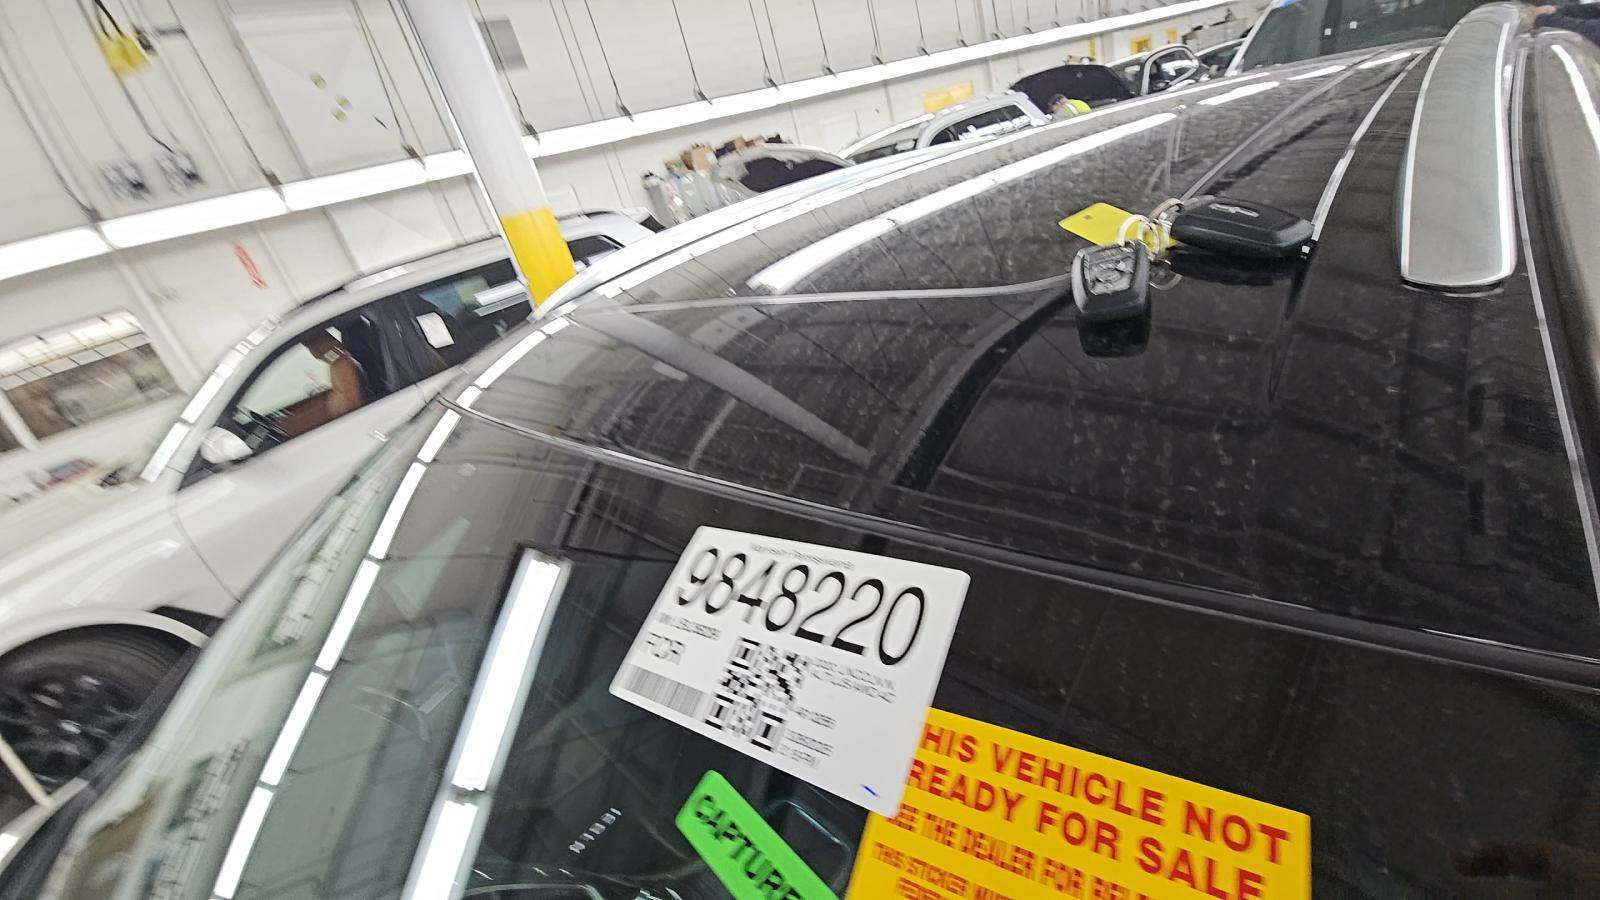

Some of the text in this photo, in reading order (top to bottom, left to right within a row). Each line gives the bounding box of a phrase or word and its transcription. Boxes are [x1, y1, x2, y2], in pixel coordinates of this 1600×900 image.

[675, 547, 926, 666] 9848220
[886, 802, 919, 833] EE
[919, 811, 960, 850] THE
[960, 825, 1036, 880] DEALER
[1037, 856, 1084, 900] FOR
[906, 758, 1029, 823] READY
[1034, 800, 1121, 861] FOR
[1136, 836, 1266, 900] SALE
[919, 722, 1291, 865] HIS VEHICLE NOT
